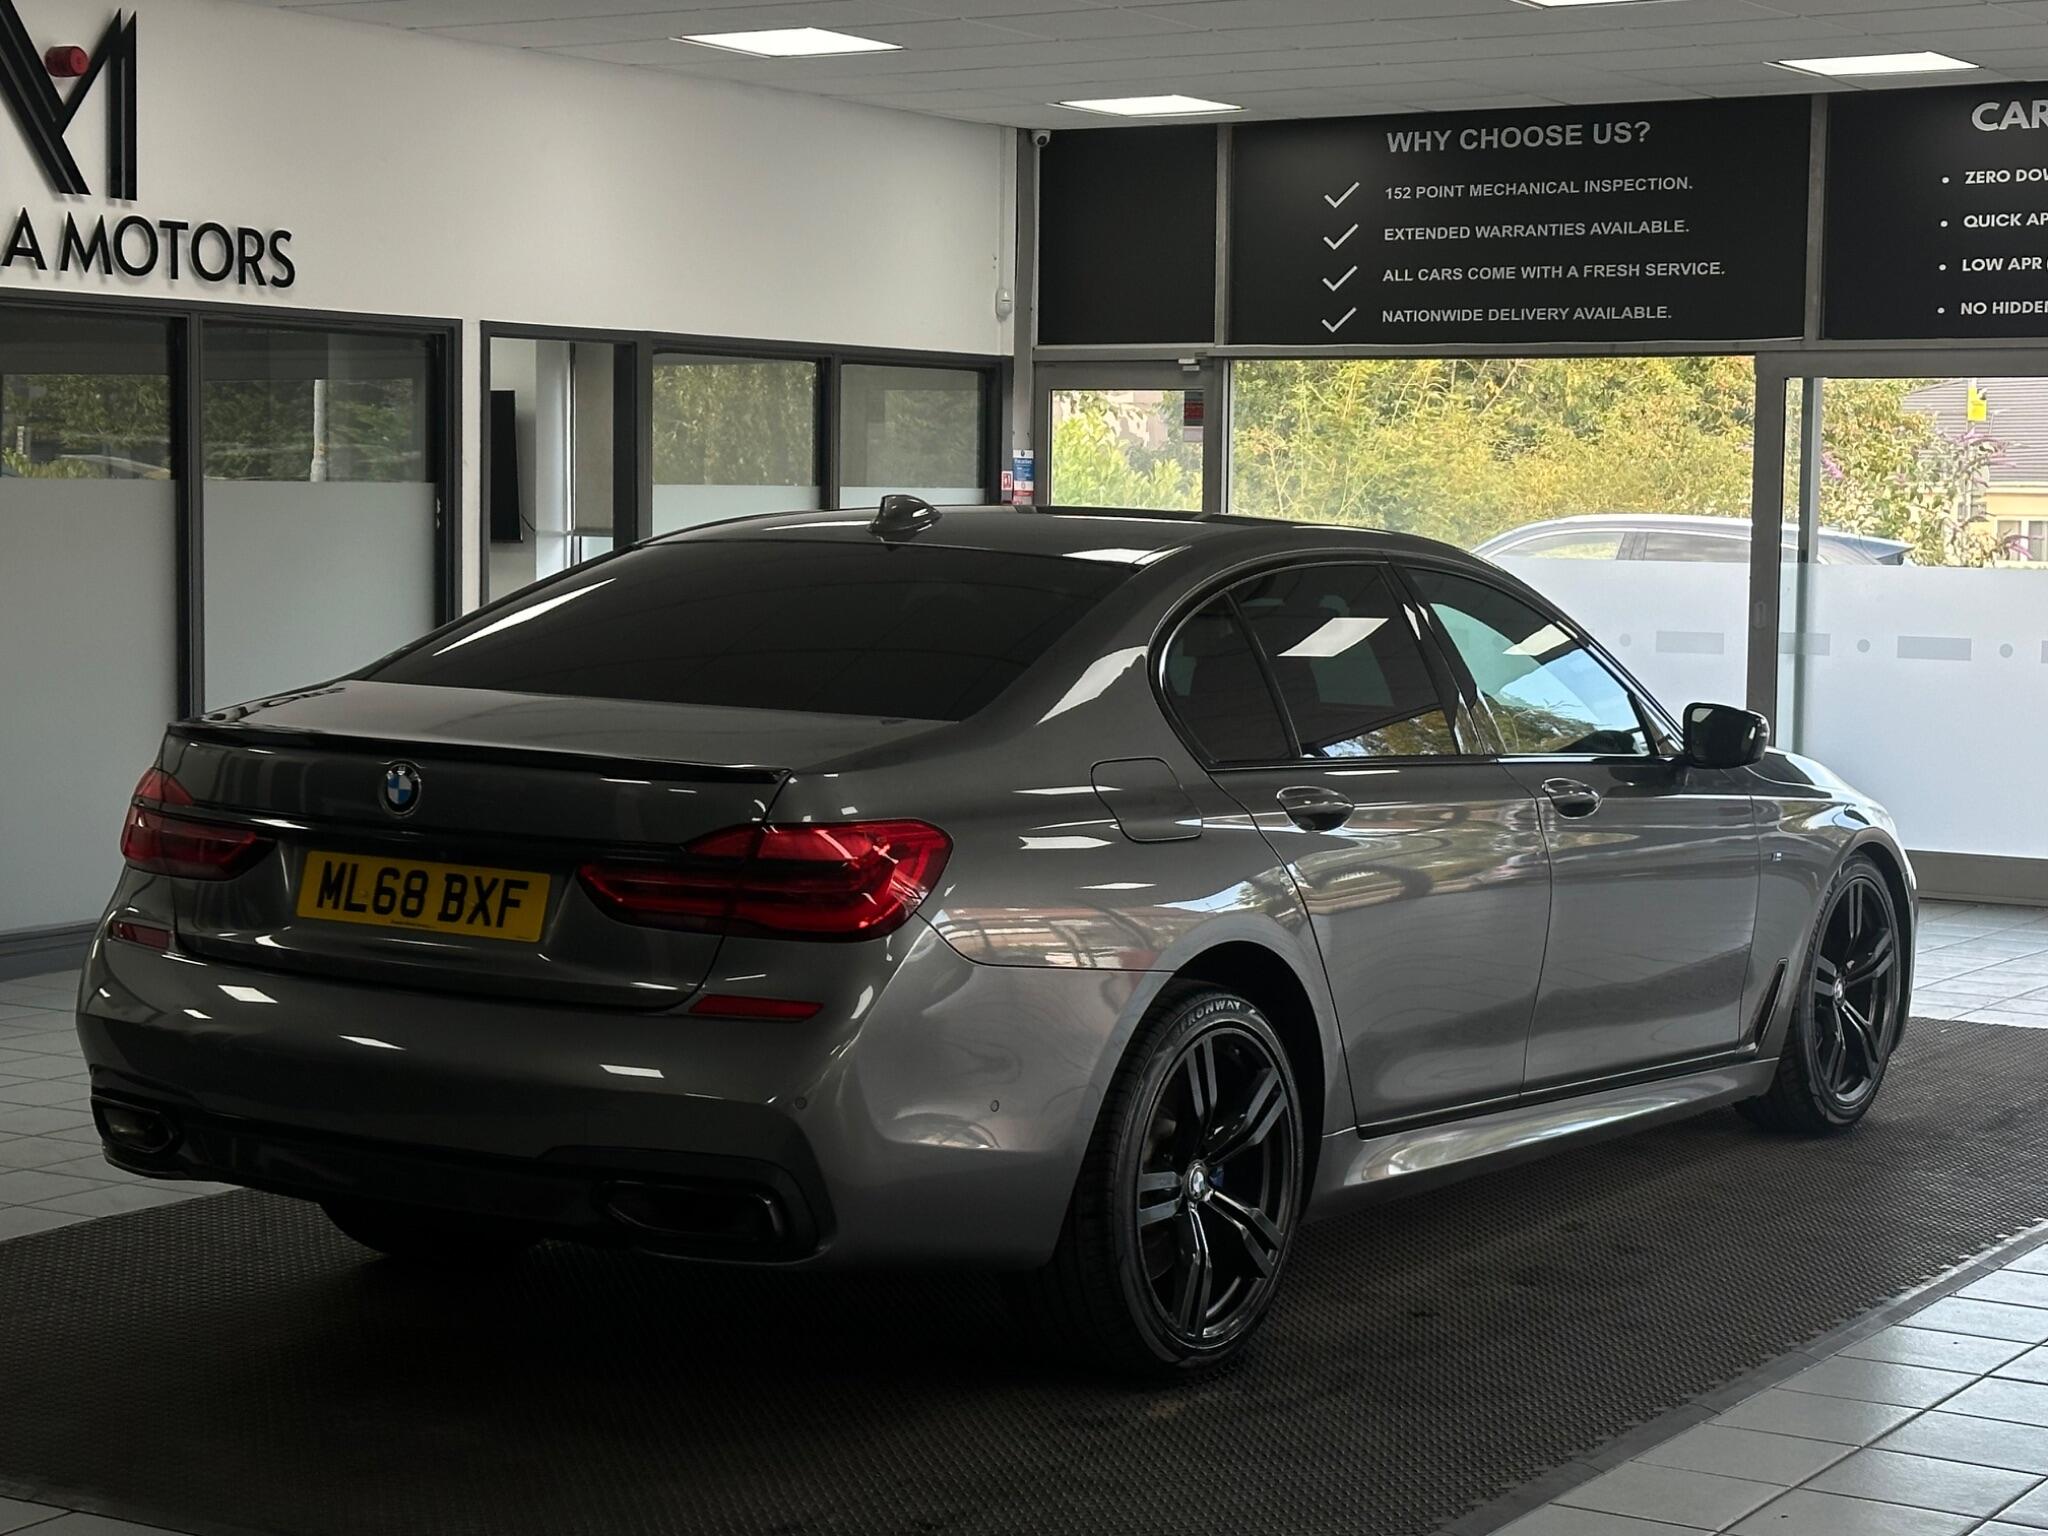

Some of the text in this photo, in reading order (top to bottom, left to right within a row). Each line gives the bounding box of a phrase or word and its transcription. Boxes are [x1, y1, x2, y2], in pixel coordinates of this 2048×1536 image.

[1387, 121, 1650, 153] WHY CHOOSE US?
[1965, 169, 2011, 184] ZERO
[1385, 176, 1693, 200] 152 POINT MECHANICAL INSPECTION.
[1384, 219, 1690, 241] EXTENDED WARRANTIES AVAILABLE.
[1963, 213, 2023, 229] QUICK
[60, 211, 296, 289] MOTORS
[1382, 262, 1726, 282] ALL CARS COME WITH A FRESH SERVICE.
[1962, 257, 2043, 272] LOW APR
[1382, 306, 1672, 323] NATIONWIDE DELIVERY AVAILABLE.
[1960, 301, 1987, 315] NO
[316, 860, 530, 929] ML68 BXF
